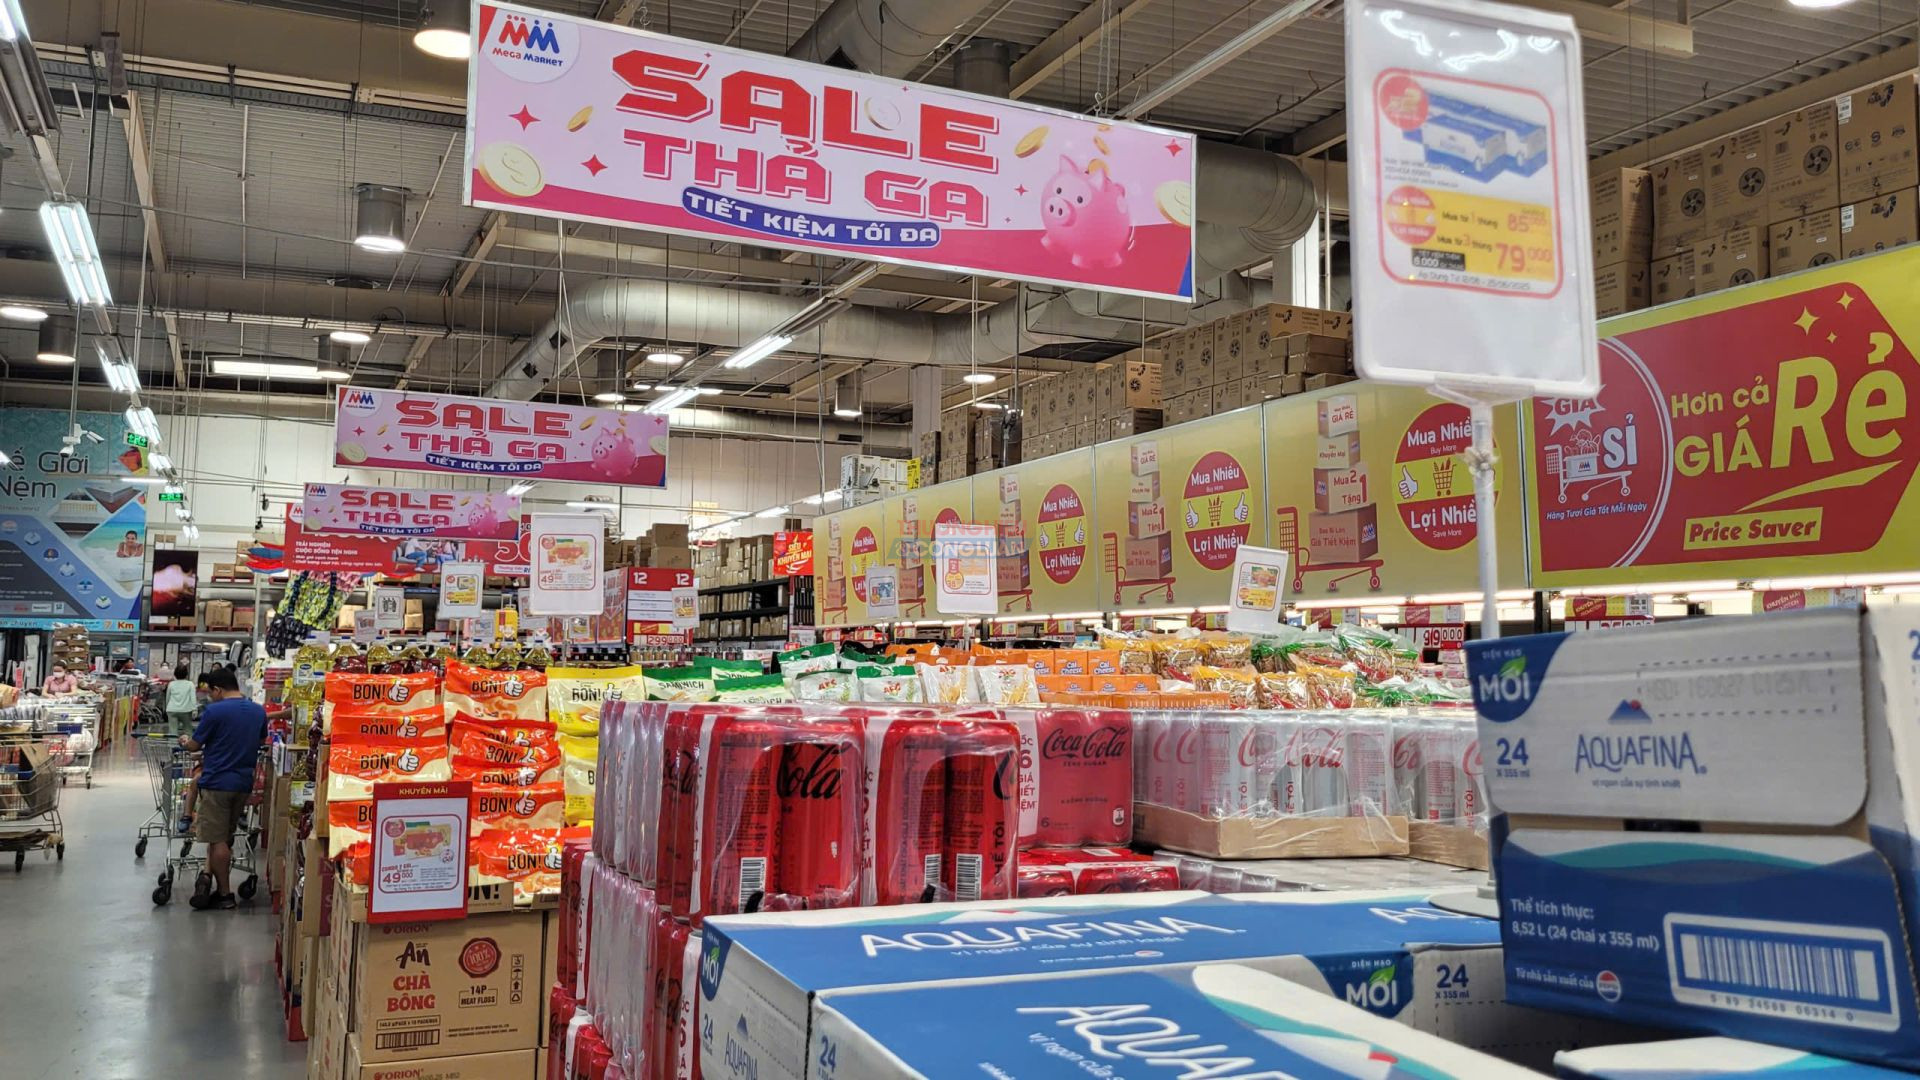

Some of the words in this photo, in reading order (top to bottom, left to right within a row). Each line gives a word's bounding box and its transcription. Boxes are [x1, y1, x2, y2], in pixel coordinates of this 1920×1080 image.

[492, 46, 523, 61] Mega
[523, 53, 564, 68] Market
[612, 49, 1000, 175] SALE
[624, 128, 834, 206] THẢ
[864, 169, 990, 229] GA
[687, 192, 753, 222] TIẾT
[763, 208, 836, 240] KIỆM
[846, 224, 892, 247] TỐI
[900, 229, 938, 249] ĐA
[1671, 389, 1724, 418] Hơn
[1731, 376, 1770, 408] cả
[1770, 332, 1908, 469] Rẻ
[396, 399, 574, 439] SALE
[1407, 429, 1437, 448] Mua
[1441, 416, 1472, 444] Nhiề
[401, 430, 493, 457] THẢ
[508, 440, 567, 463] GA
[1430, 446, 1442, 456] Buy
[1442, 444, 1458, 453] More
[1675, 414, 1764, 478] GIÁ
[38, 451, 89, 475] Giới
[428, 454, 457, 466] TIẾT
[462, 460, 495, 472] KIỆM
[499, 462, 522, 472] TỐI
[1191, 472, 1210, 487] Mua
[1213, 463, 1240, 484] Nhiều
[1333, 476, 1349, 487] Mua
[1350, 470, 1357, 483] 2
[1359, 474, 1367, 504] 1
[340, 489, 456, 512] SALE
[1043, 501, 1057, 513] Mua
[343, 508, 403, 526] THẢ
[412, 513, 452, 526] GA
[1410, 508, 1437, 532] Lợi
[1441, 499, 1477, 526] Nhiề
[1546, 510, 1565, 521] Hàng
[1567, 508, 1583, 518] Tươi
[1584, 507, 1597, 517] Giá
[1611, 503, 1626, 514] Mỗi
[1627, 501, 1648, 513] Ngày
[1432, 531, 1447, 539] Save
[1448, 528, 1462, 537] More
[1688, 523, 1741, 543] Price
[1748, 518, 1817, 540] Saver
[1193, 536, 1211, 556] Lợi
[1045, 556, 1058, 573] Lợi
[634, 572, 648, 585] 12
[676, 573, 690, 586] 12
[117, 621, 134, 630] Km
[1067, 660, 1078, 670] Cal
[1100, 660, 1110, 670] Cal
[353, 684, 386, 700] BON!
[471, 680, 502, 694] BON!
[572, 687, 602, 701] BON!
[1020, 750, 1033, 769] 6
[1496, 737, 1529, 766] 24
[1575, 732, 1700, 775] AQUAFINA
[361, 755, 396, 770] BON!
[399, 786, 432, 795] KHUYẾN
[1020, 785, 1035, 796] IẾT
[480, 796, 513, 813] BON!
[1041, 817, 1050, 828] 6
[508, 854, 542, 870] BON!
[1510, 896, 1532, 914] Thể
[1533, 899, 1559, 916] tích
[1561, 903, 1594, 922] thực:
[394, 925, 430, 935] ORION
[861, 917, 1238, 958] AQUAFINA
[1512, 920, 1535, 937] 8,52
[1538, 924, 1546, 937] L
[1547, 925, 1568, 942] (24
[1570, 927, 1596, 943] chai
[1599, 933, 1607, 944] x
[1608, 930, 1633, 948] 355
[1636, 935, 1660, 952] ml)
[392, 970, 432, 992] CHÀ
[1435, 963, 1469, 990] 24
[470, 984, 487, 996] 14P
[478, 994, 497, 1005] FLOSS
[386, 993, 437, 1013] BÔNG
[703, 1013, 714, 1045] 24
[819, 1035, 837, 1073] 24
[384, 1069, 422, 1080] ORION
